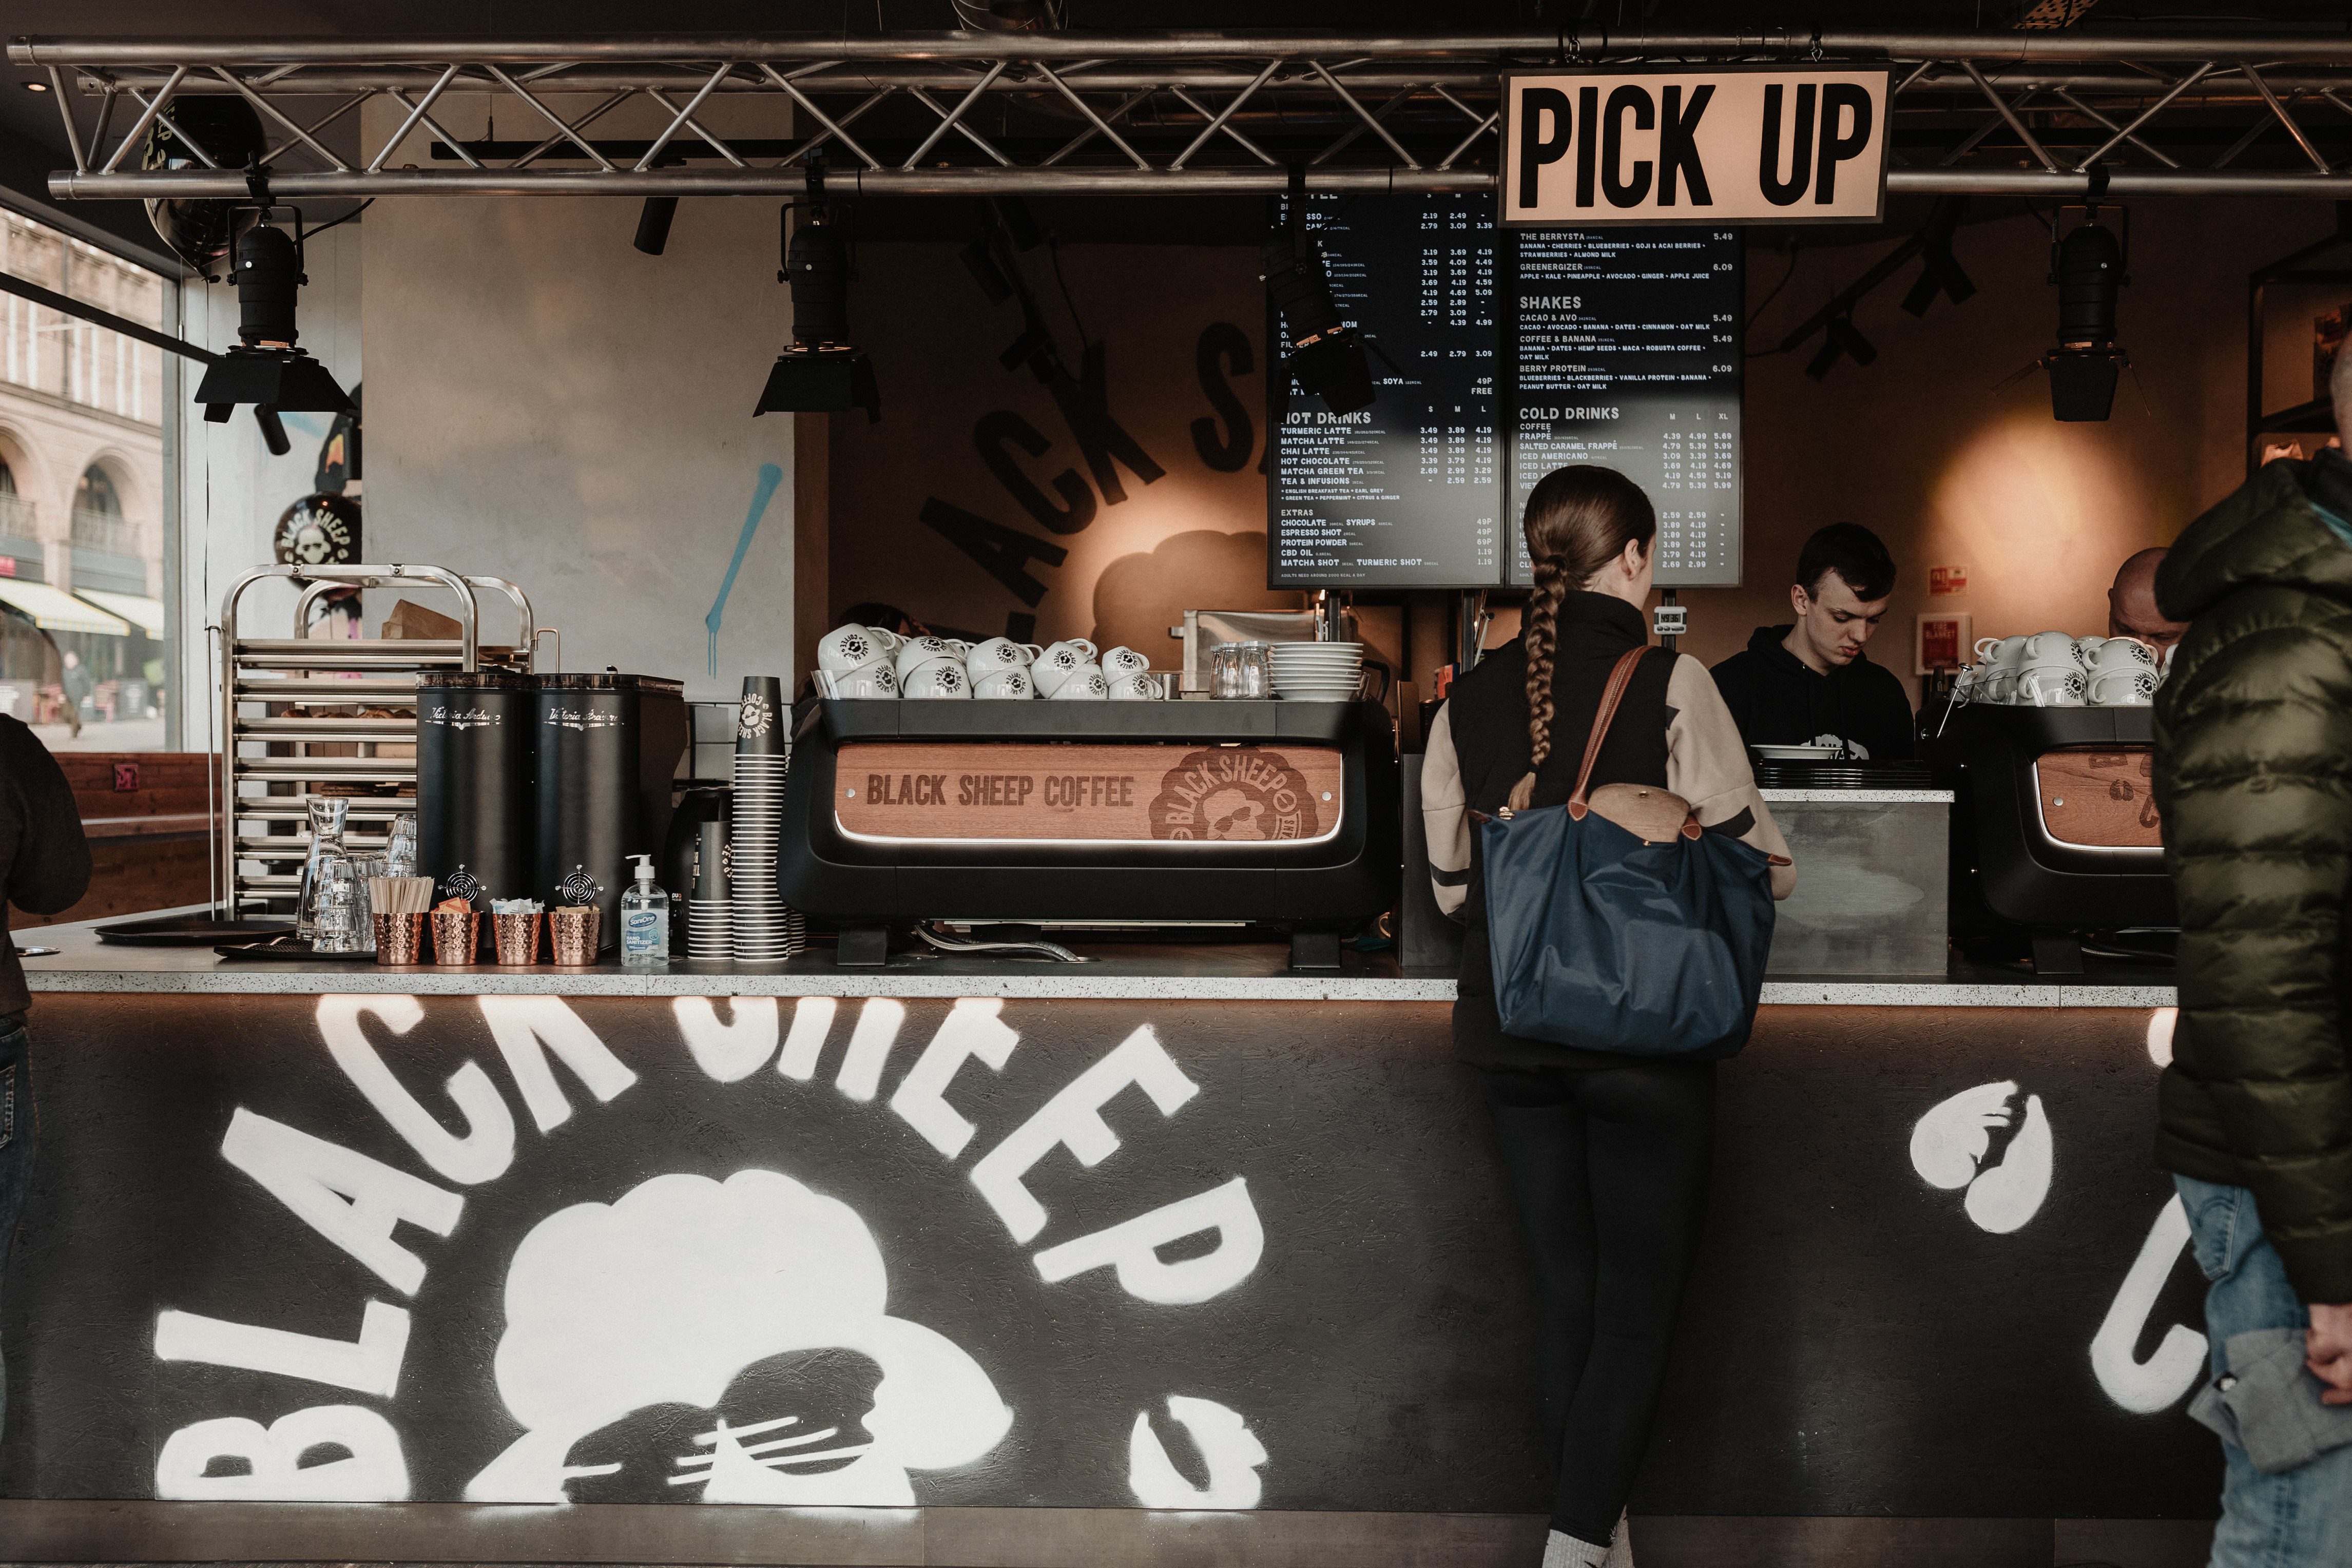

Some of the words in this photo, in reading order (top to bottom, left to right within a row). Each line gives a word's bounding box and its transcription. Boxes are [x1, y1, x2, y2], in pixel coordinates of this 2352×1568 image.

[1519, 85, 1716, 208] PICK
[1760, 83, 1872, 206] UP
[1520, 296, 1581, 309] SHAKES
[1318, 412, 1371, 424] DRINKS
[1520, 408, 1559, 419] COLD
[1566, 408, 1619, 419] DRINKS
[1520, 430, 1551, 440] FRAPPÉ
[1588, 440, 1617, 450] FRAPPÉ
[314, 509, 351, 545] SHEEP
[753, 712, 773, 737] BLACK
[867, 774, 947, 805] BLACK
[958, 775, 1033, 806] SHEEP
[1044, 776, 1134, 807] COFFEE
[1165, 760, 1220, 824] BLACK
[1219, 755, 1287, 792] SHEEP
[1282, 820, 1295, 839] ANS
[630, 916, 655, 925] SaniOne
[154, 994, 637, 1501] BLACK
